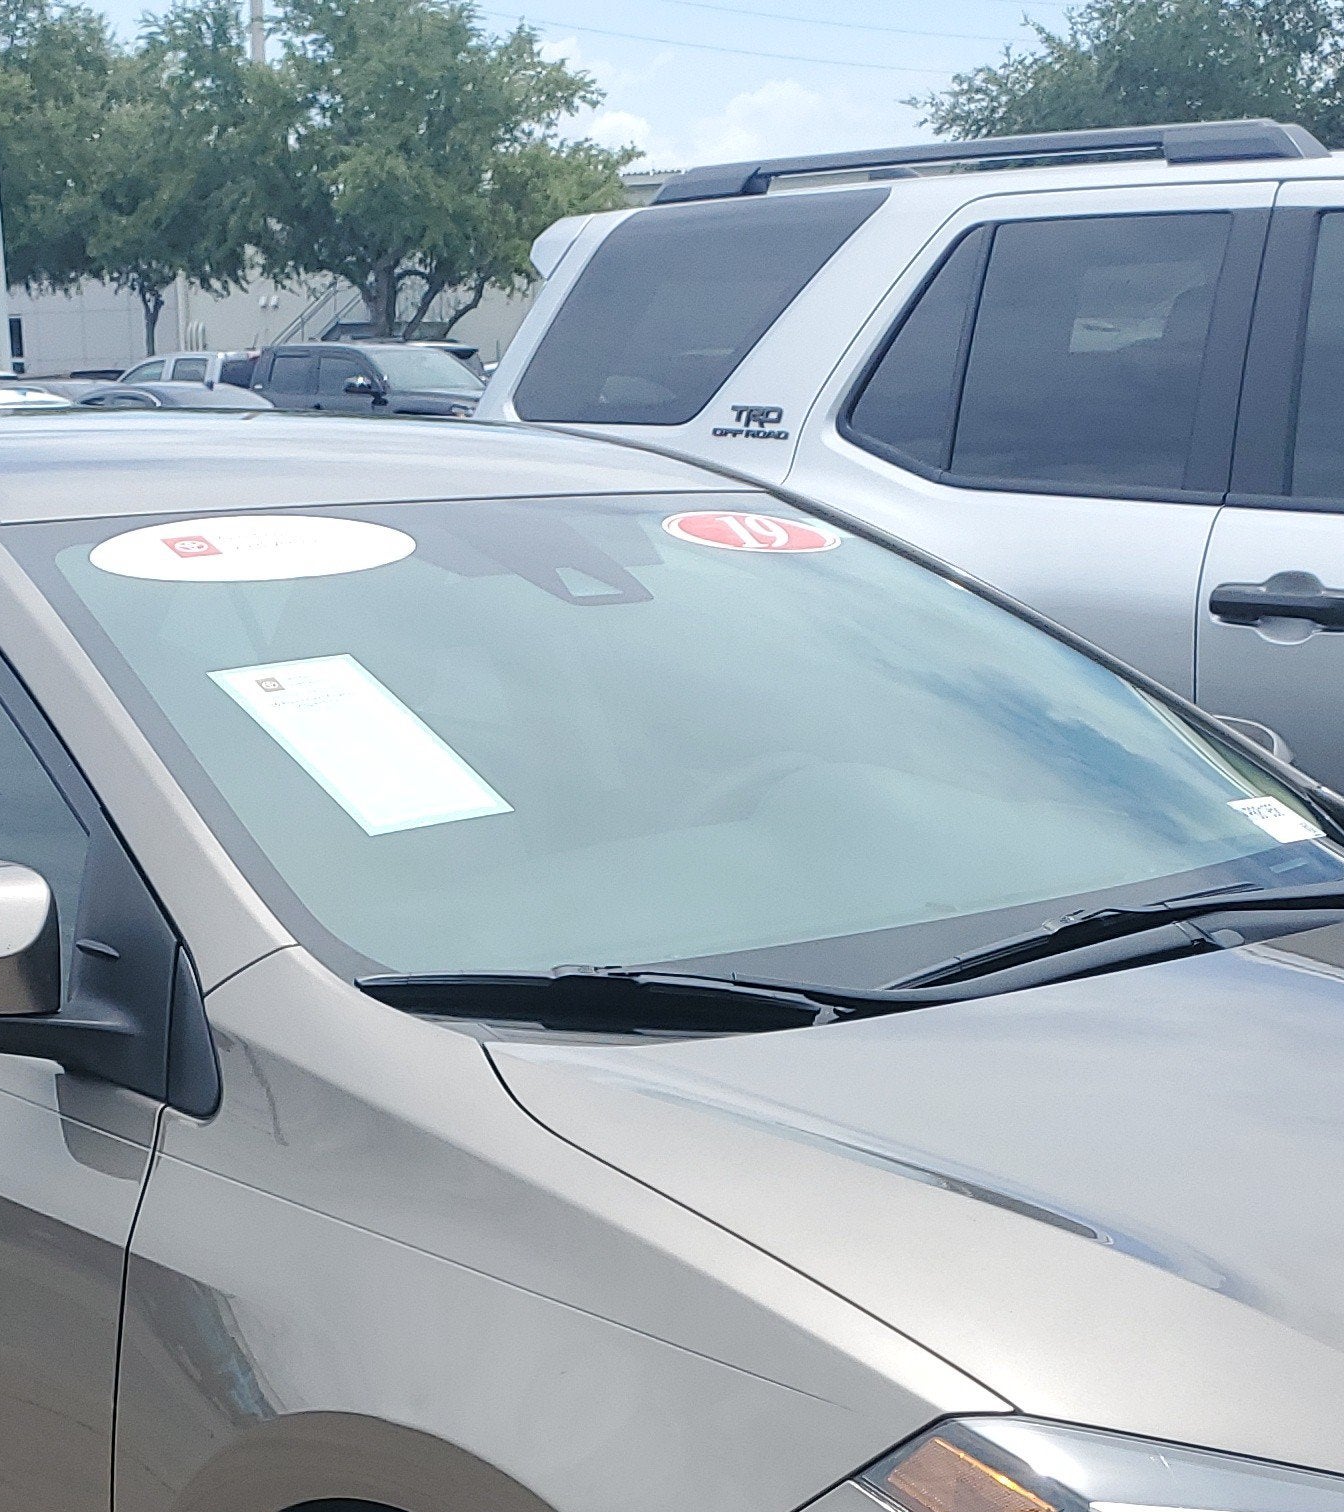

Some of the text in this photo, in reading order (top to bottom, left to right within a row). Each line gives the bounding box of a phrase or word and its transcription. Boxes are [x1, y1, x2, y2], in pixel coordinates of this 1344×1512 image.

[731, 404, 783, 428] TRD
[712, 428, 790, 440] OFF ROAD
[715, 515, 789, 548] 19
